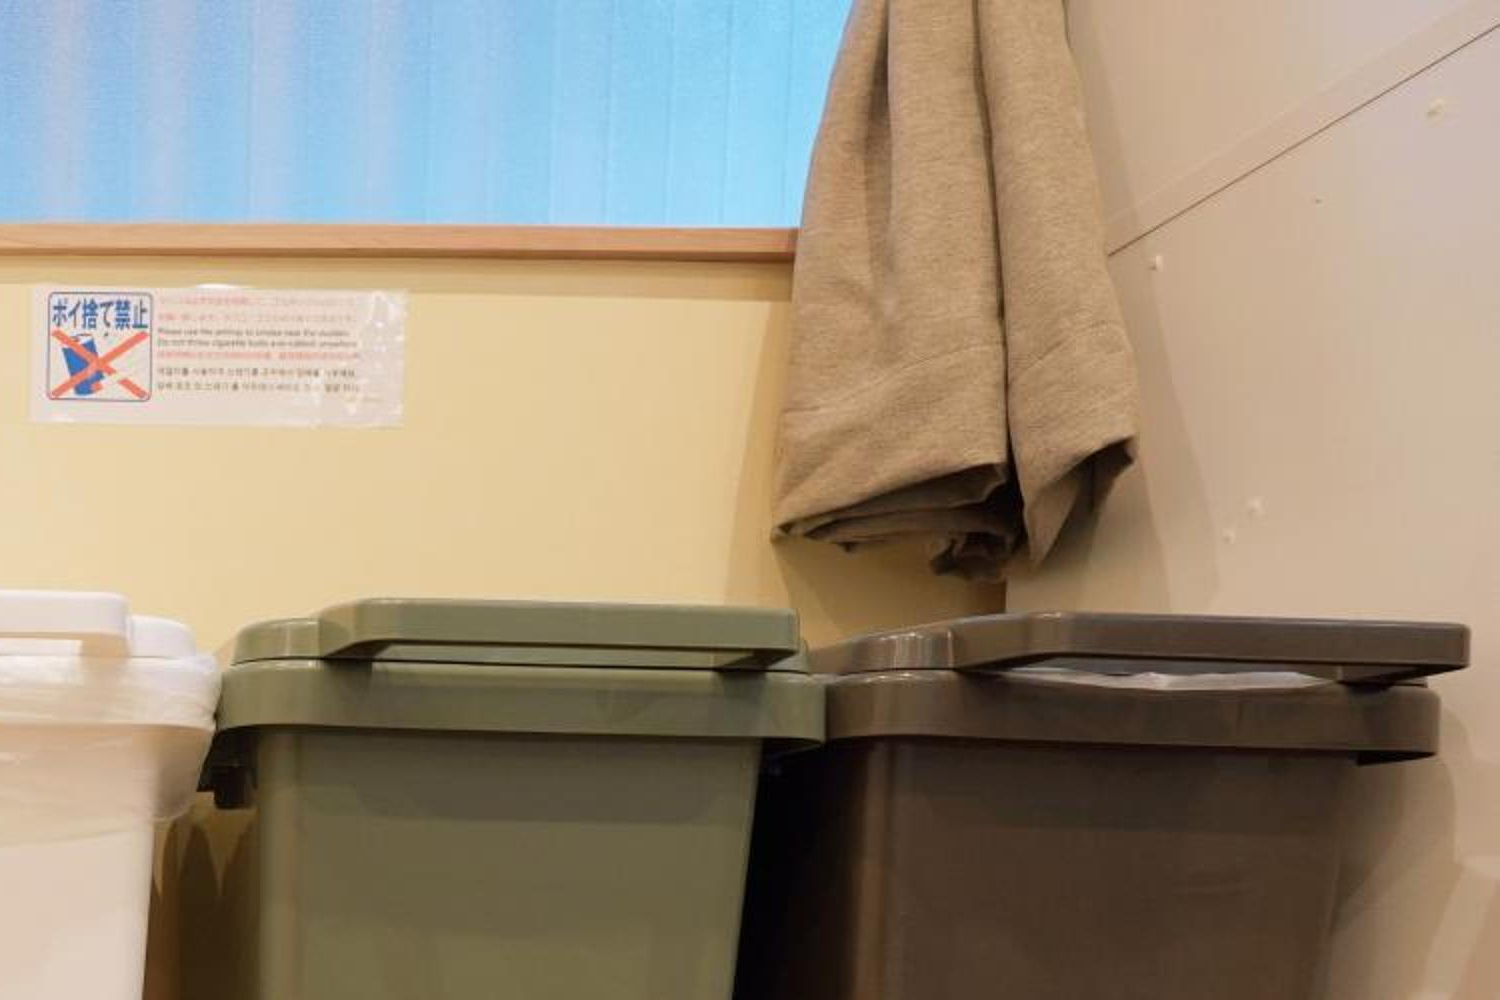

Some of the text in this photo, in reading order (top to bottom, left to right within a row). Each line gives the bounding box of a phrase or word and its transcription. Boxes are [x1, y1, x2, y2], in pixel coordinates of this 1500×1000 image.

[52, 297, 148, 330] ポイ捨て禁止
